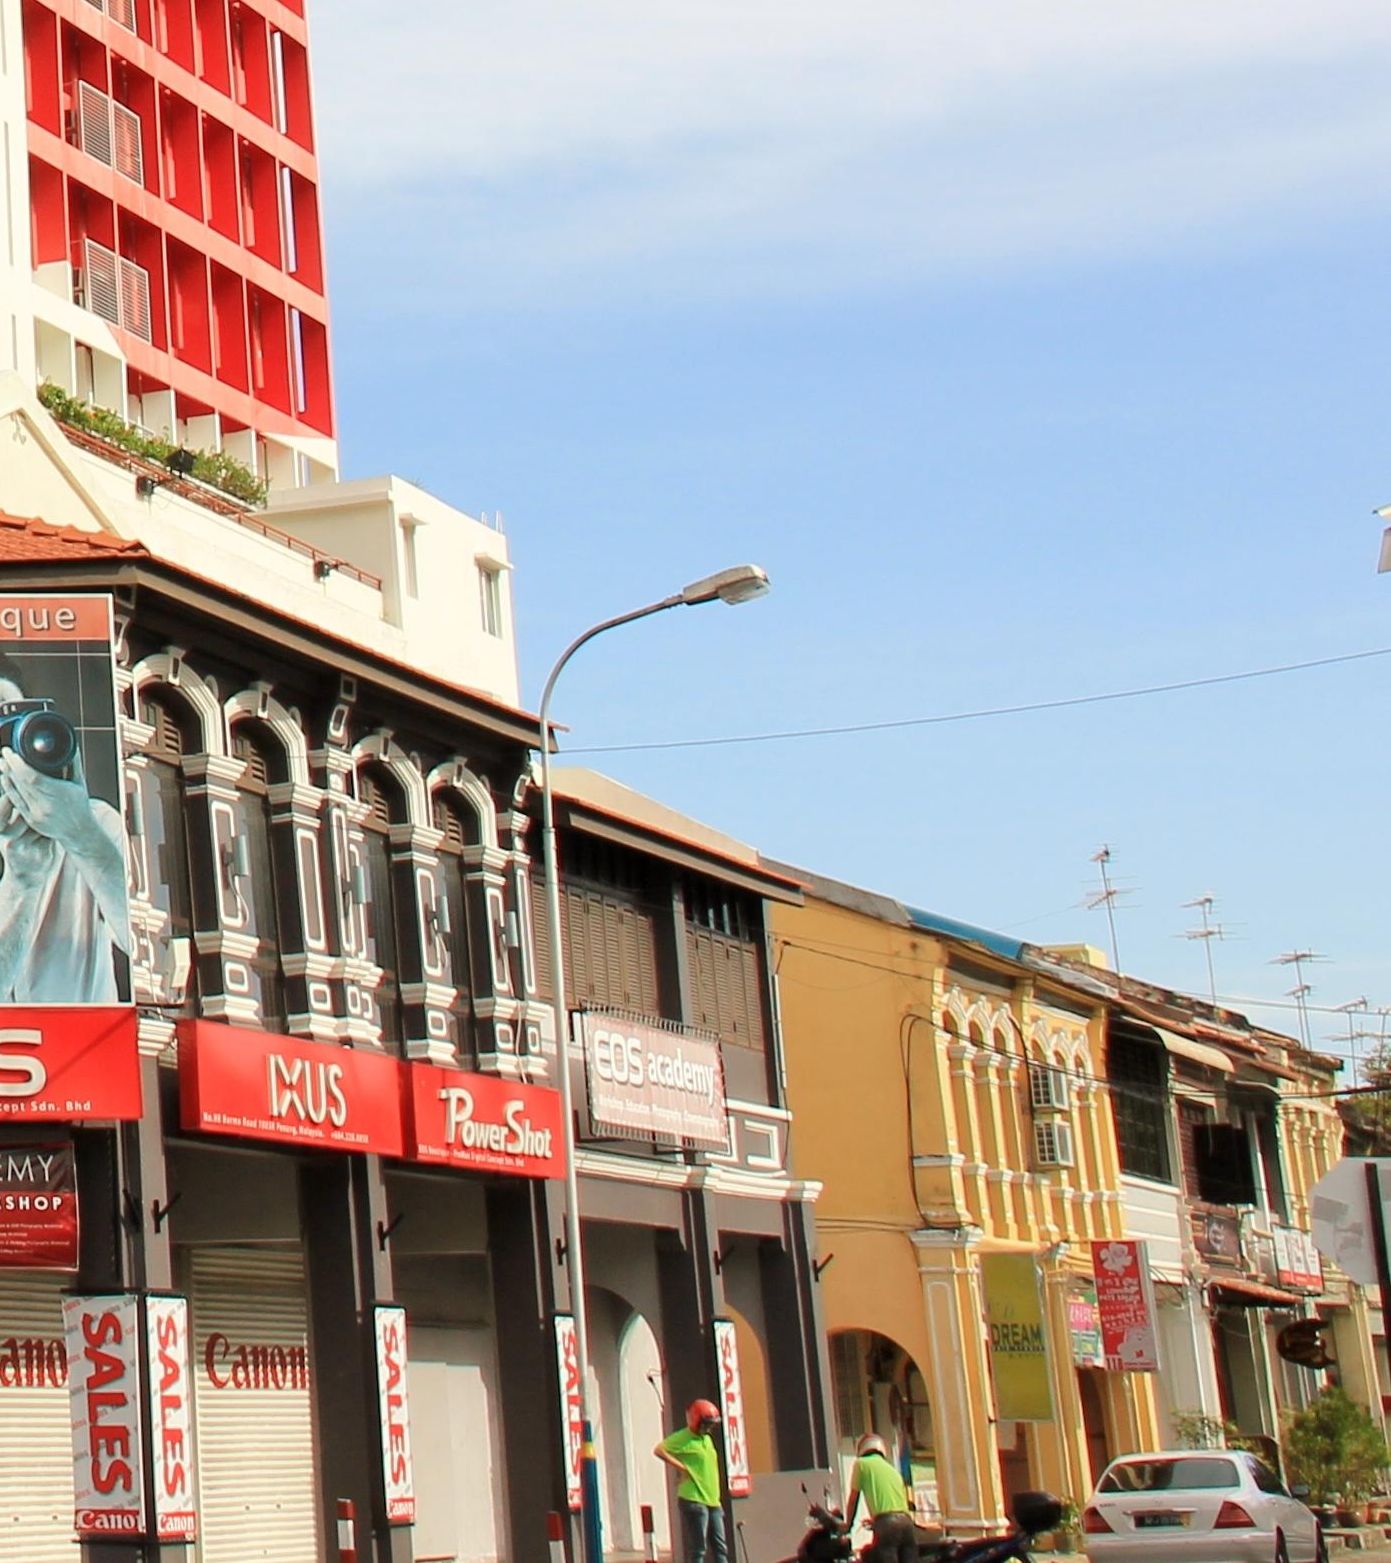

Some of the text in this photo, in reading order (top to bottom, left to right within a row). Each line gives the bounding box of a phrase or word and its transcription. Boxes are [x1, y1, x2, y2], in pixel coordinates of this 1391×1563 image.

[269, 1053, 348, 1127] IXUS
[594, 1030, 715, 1108] EOS academy
[30, 1100, 60, 1113] Sdn.
[66, 1100, 92, 1113] Bhd
[438, 1087, 553, 1159] PowerShot
[205, 1332, 309, 1390] Canon
[992, 1324, 1043, 1346] DREAM
[81, 1311, 133, 1495] SALES
[156, 1315, 186, 1498] SALES
[384, 1323, 407, 1485] SALES
[720, 1333, 742, 1466] SALES
[158, 1514, 195, 1532] Canon
